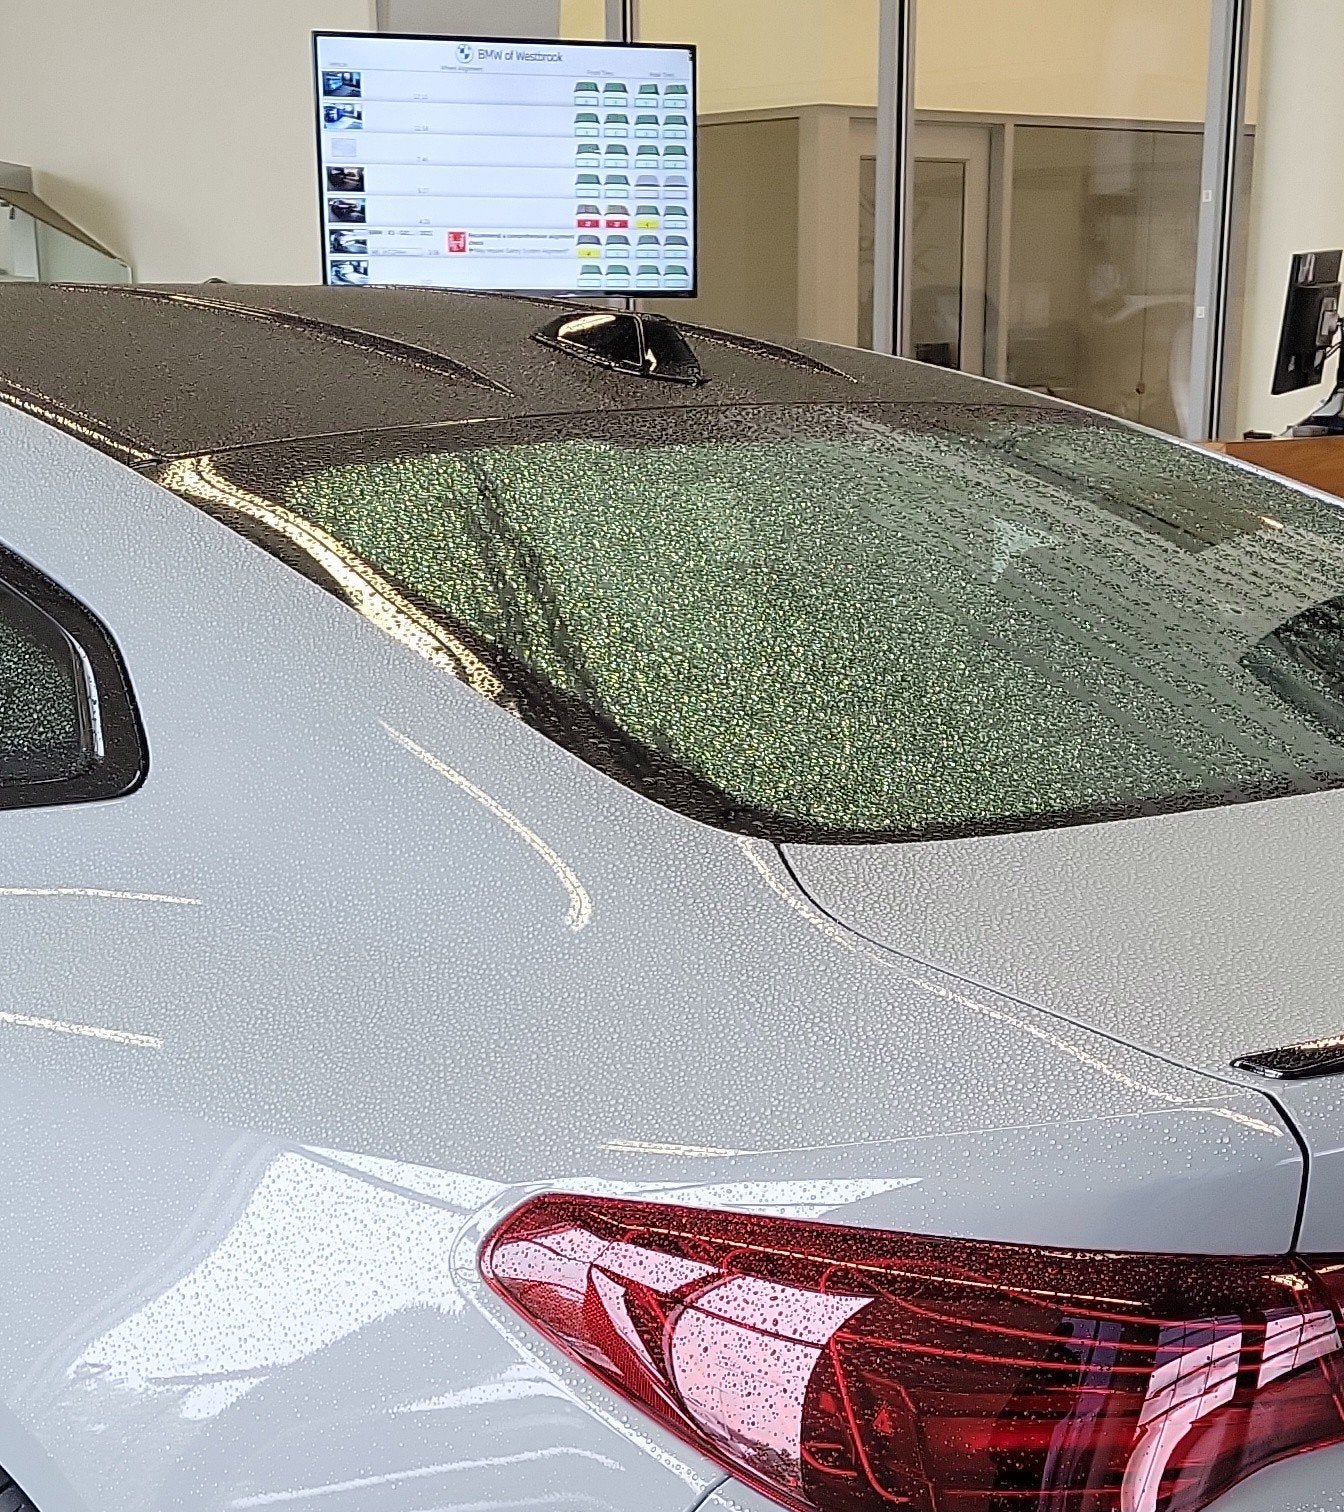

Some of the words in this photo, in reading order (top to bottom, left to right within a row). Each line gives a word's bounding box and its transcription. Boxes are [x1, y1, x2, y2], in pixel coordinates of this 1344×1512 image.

[478, 49, 502, 60] BMW
[505, 50, 514, 60] of
[516, 50, 563, 62] Westbrook
